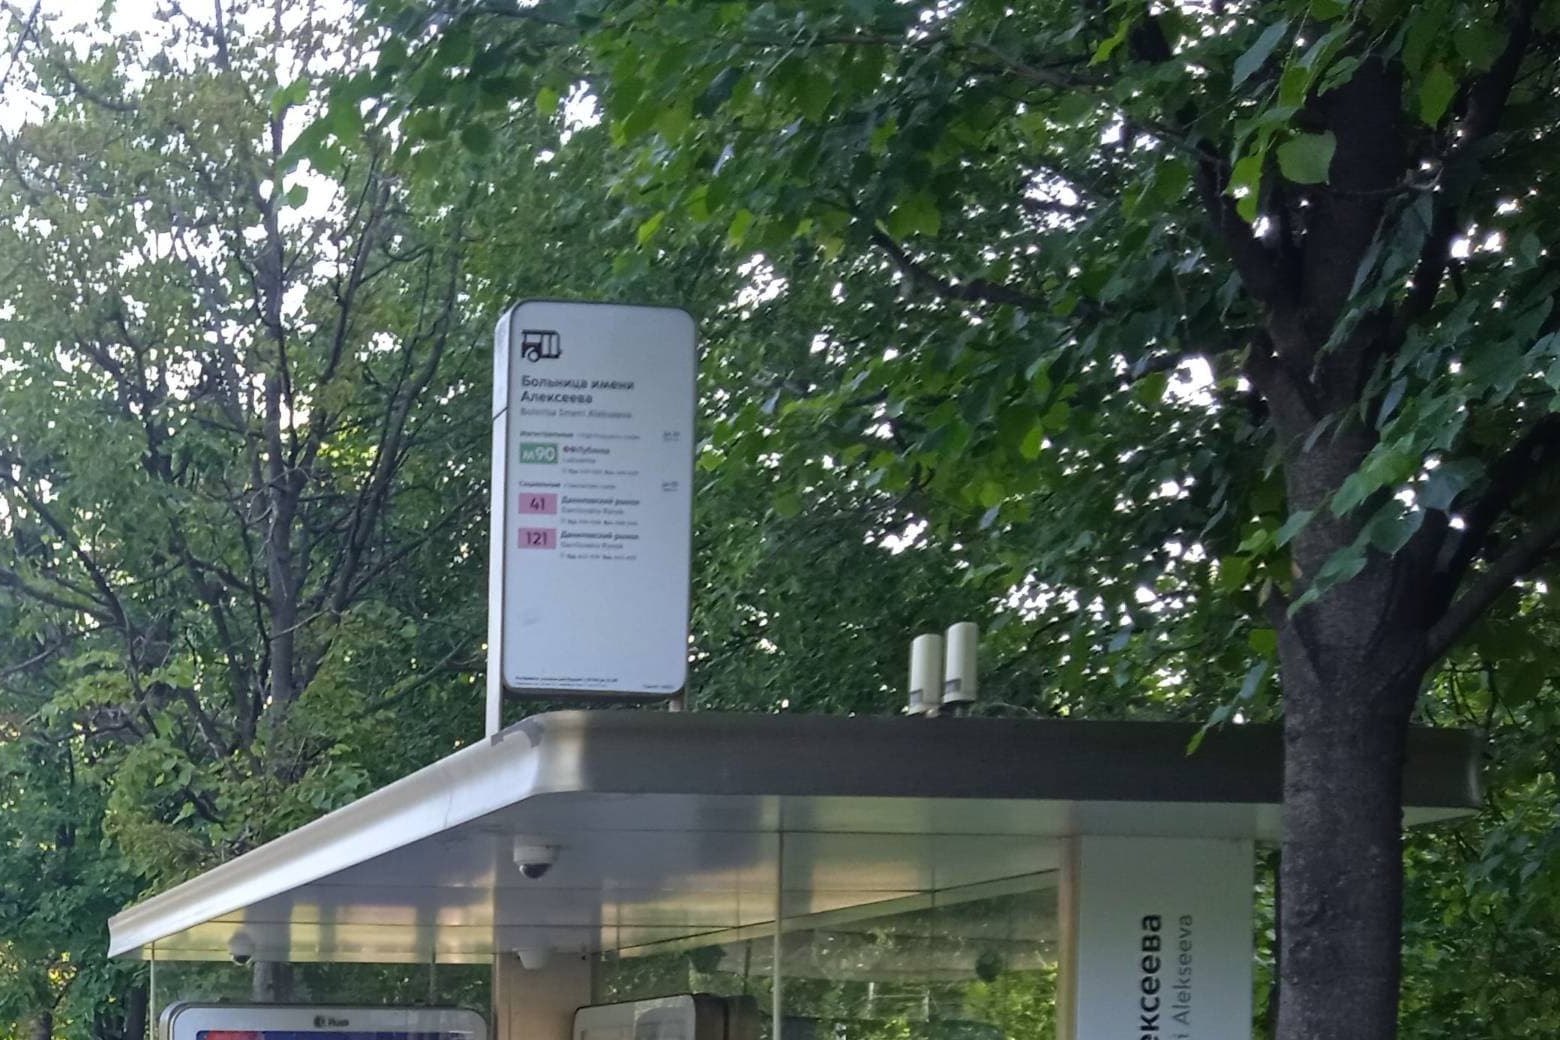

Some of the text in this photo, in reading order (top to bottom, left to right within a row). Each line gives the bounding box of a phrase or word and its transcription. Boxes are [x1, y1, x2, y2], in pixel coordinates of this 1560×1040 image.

[529, 497, 545, 511] 41
[526, 531, 548, 545] 121
[1171, 913, 1193, 1026] Alekseeva
